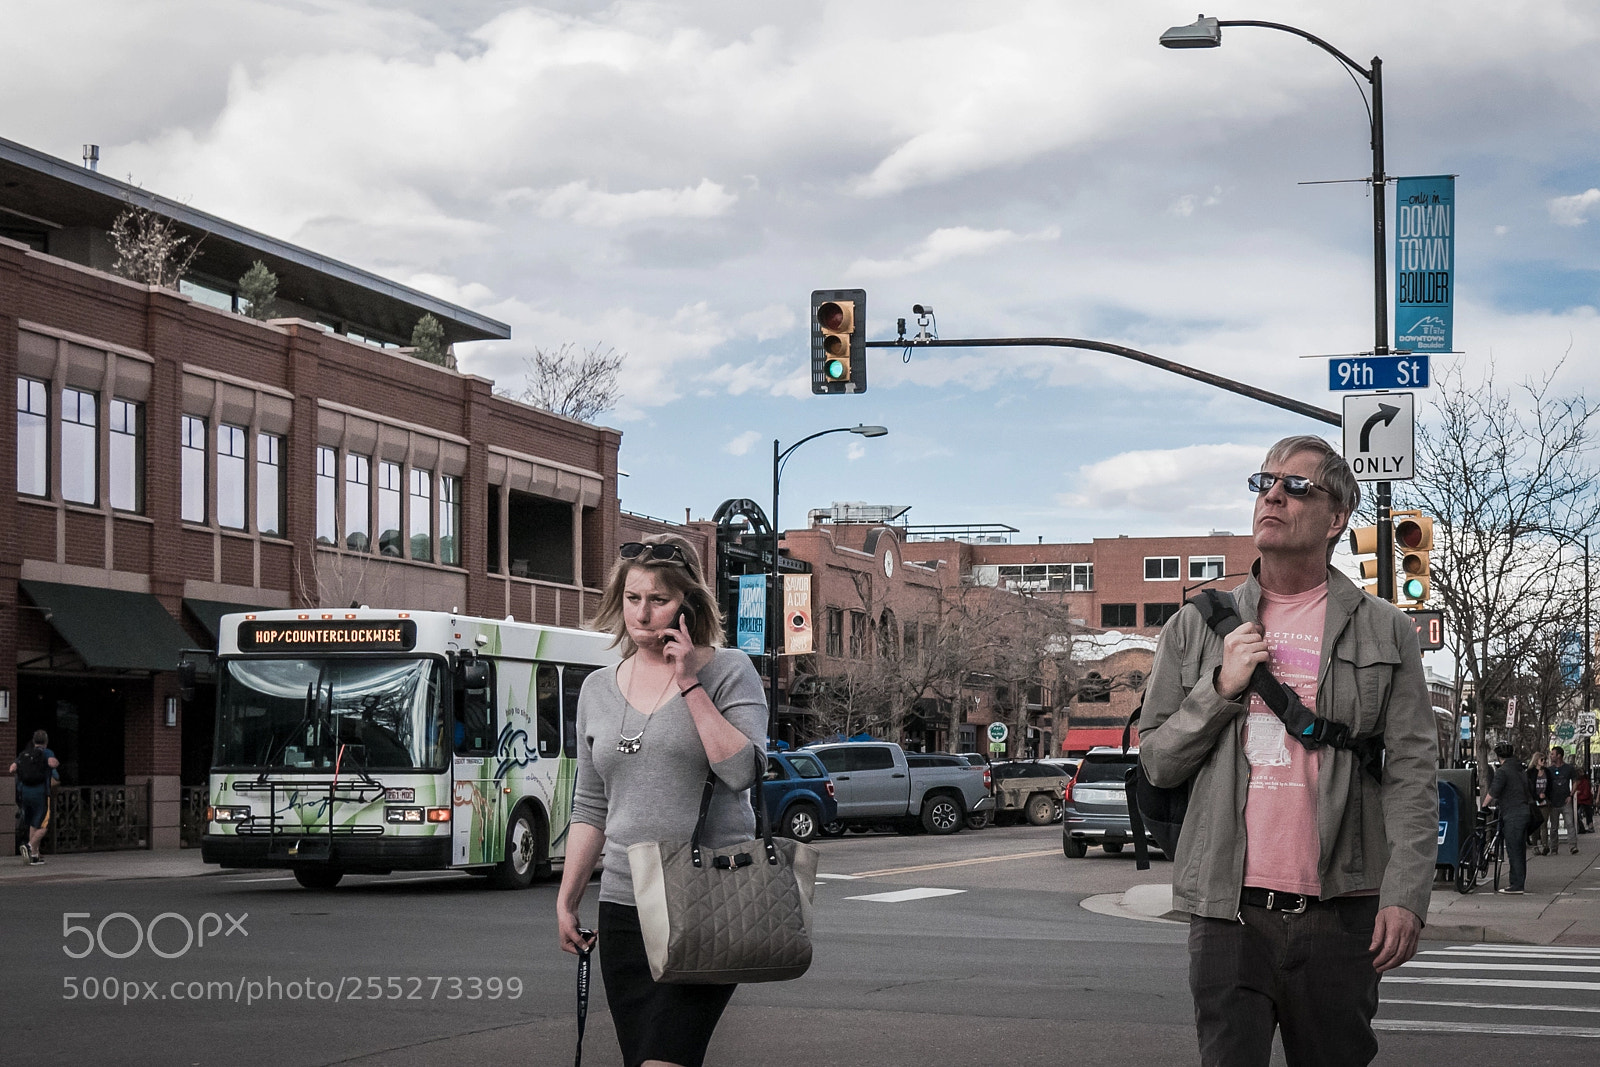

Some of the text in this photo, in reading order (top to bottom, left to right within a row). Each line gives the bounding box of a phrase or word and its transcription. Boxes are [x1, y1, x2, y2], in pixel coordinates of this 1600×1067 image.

[1408, 190, 1440, 209] only in
[1400, 205, 1450, 238] DOWN
[1399, 238, 1450, 271] TOWN
[1399, 271, 1449, 304] BOULDER
[1417, 341, 1445, 349] Boulder
[1337, 360, 1420, 386] 9th St
[1353, 456, 1404, 474] ONLY
[785, 577, 809, 592] SAVOR
[741, 587, 764, 603] DOWN
[787, 592, 808, 607] A CUP
[740, 601, 764, 618] TOWN
[739, 617, 763, 633] BOULDER
[255, 629, 401, 643] HOP/COUNTERCLOCKWISE
[1580, 724, 1595, 734] 20
